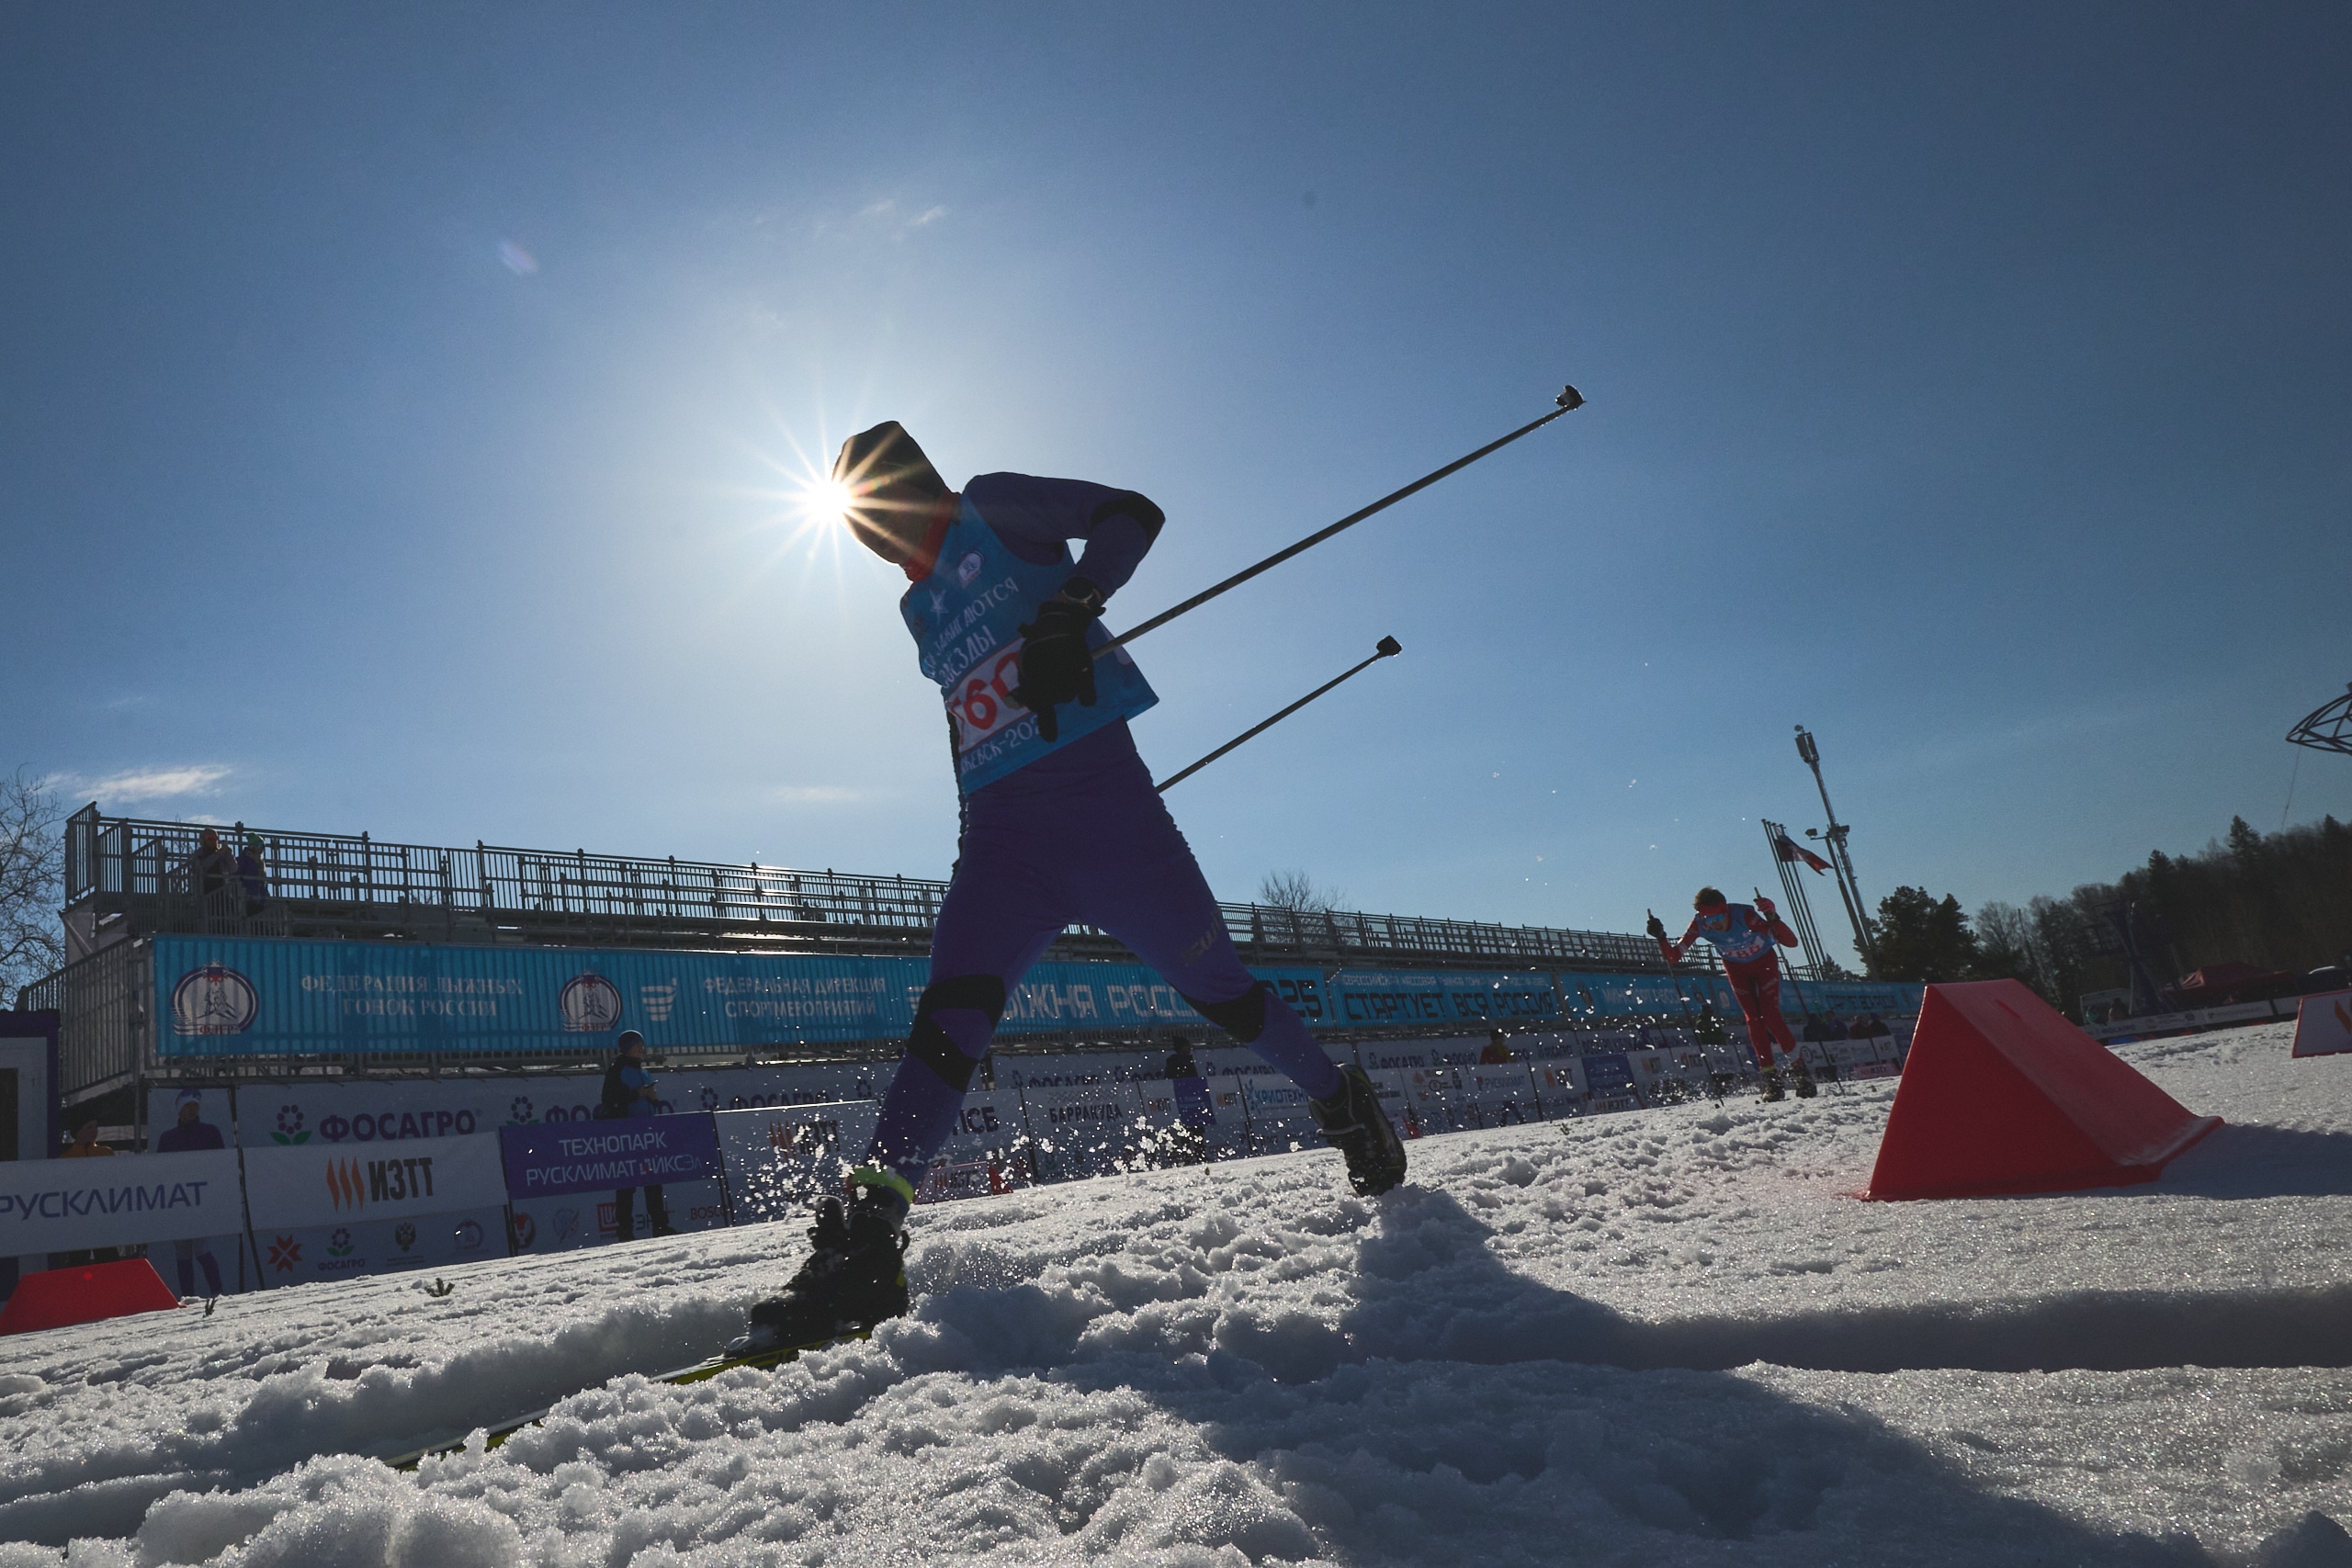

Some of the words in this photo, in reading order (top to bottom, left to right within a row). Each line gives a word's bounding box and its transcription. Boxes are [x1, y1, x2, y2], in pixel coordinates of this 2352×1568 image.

[300, 974, 429, 996] ФЕДЕРАЦИЯ
[435, 976, 523, 995] ЛЫЖНЫХ
[703, 976, 810, 996] ФЕДЕРАЛЬНАЯ
[815, 977, 886, 997] ДИРЕКЦИЯ
[343, 998, 415, 1016] ГОНОК
[421, 998, 498, 1016] РОССИИ
[725, 997, 876, 1019] СПОРТМЕРОПРИЯТИЙ
[1001, 982, 1099, 1020] ЫЖНЯ
[1344, 992, 1443, 1021] СТАРТУЕТ
[1451, 992, 1491, 1017] ВСЯ
[1492, 991, 1555, 1017] РОССИЯ
[319, 1108, 476, 1144] ФОСАГРО
[1049, 1103, 1123, 1123] БАРРАКУДА
[558, 1130, 668, 1158] ТЕХНОПАРК
[368, 1156, 435, 1202] ИЗТТ
[526, 1159, 638, 1188] РУСКЛИМАТ
[0, 1181, 209, 1221] РУСКЛИМАТ
[318, 1258, 366, 1272] ФОСАГРО
